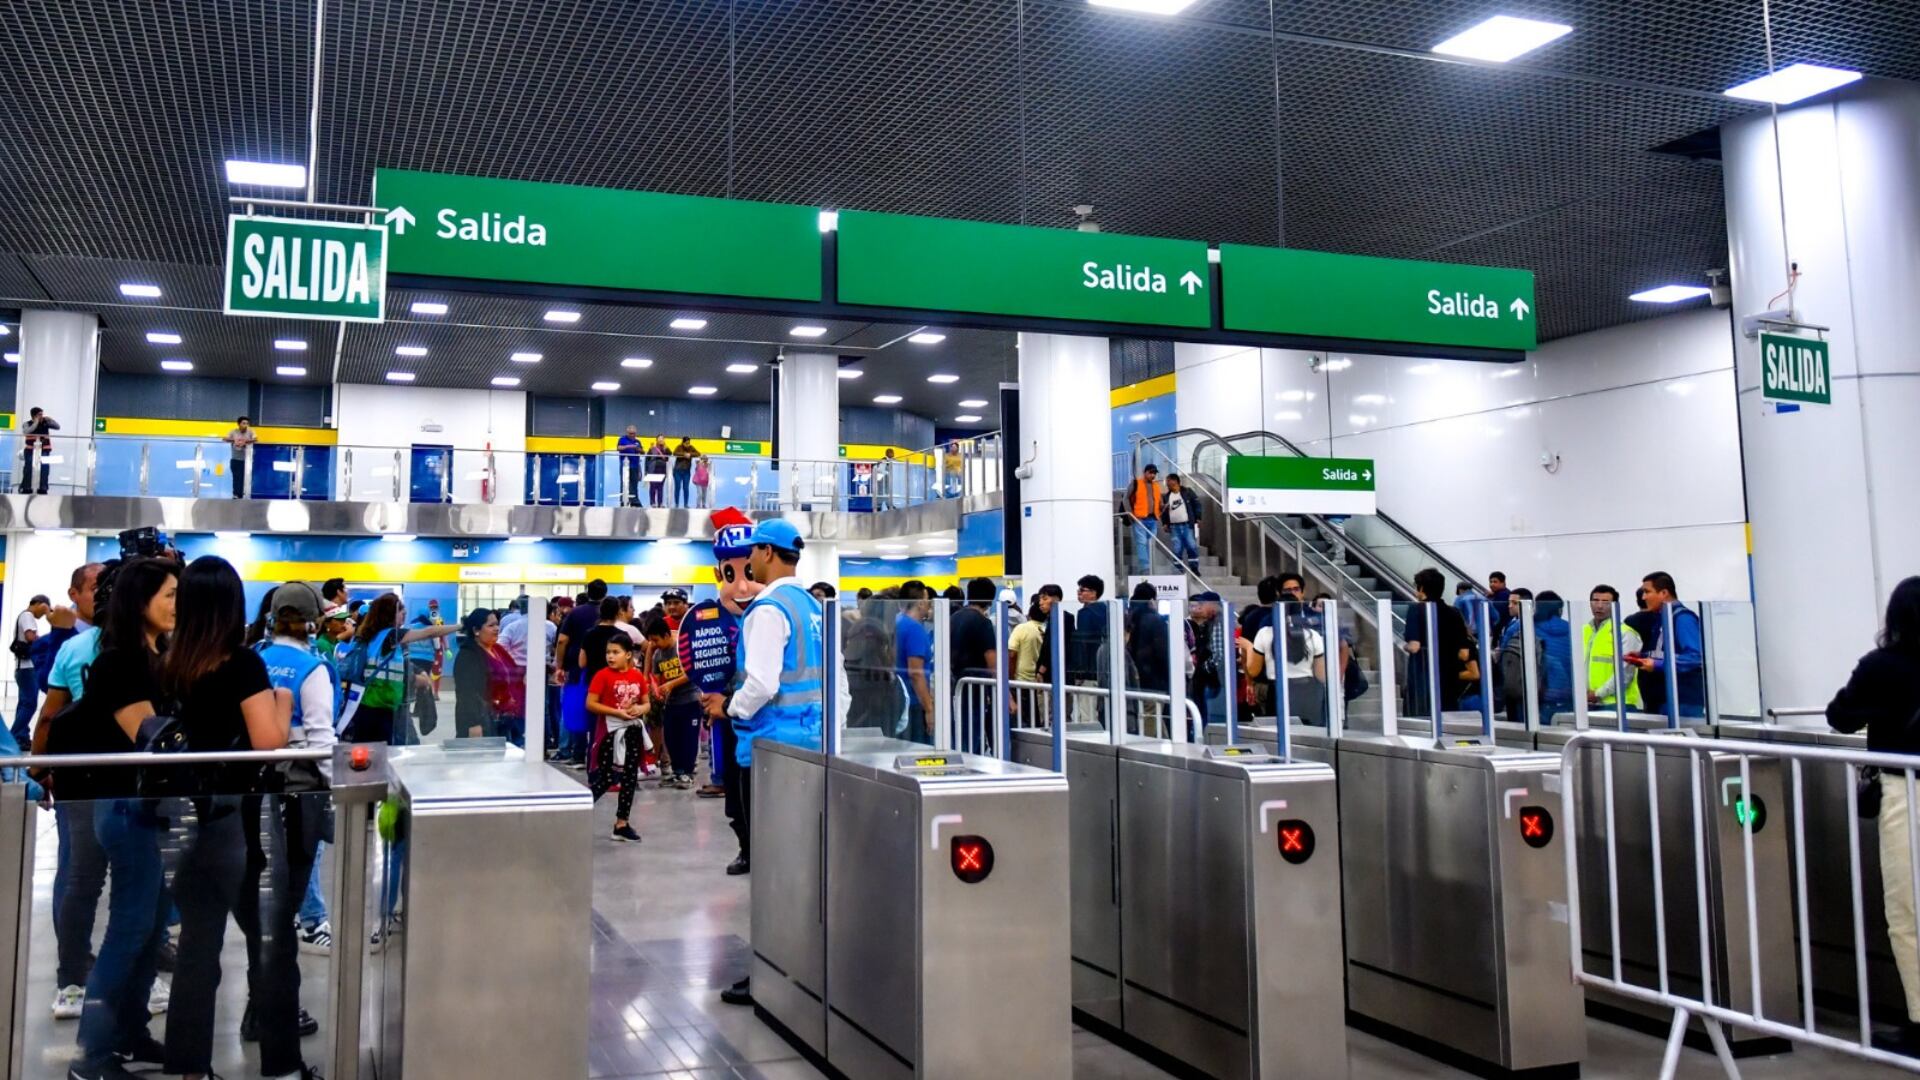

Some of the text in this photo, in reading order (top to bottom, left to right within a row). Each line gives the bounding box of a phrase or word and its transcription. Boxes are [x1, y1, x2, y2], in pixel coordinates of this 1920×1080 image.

[436, 208, 547, 247] Salida
[241, 232, 370, 305] SALIDA
[1082, 261, 1167, 293] Salida
[1427, 289, 1499, 319] Salida
[1766, 342, 1826, 395] SALIDA
[1322, 468, 1358, 481] Salida
[694, 646, 729, 659] SEGURO E
[694, 656, 731, 670] INCLUSIVO
